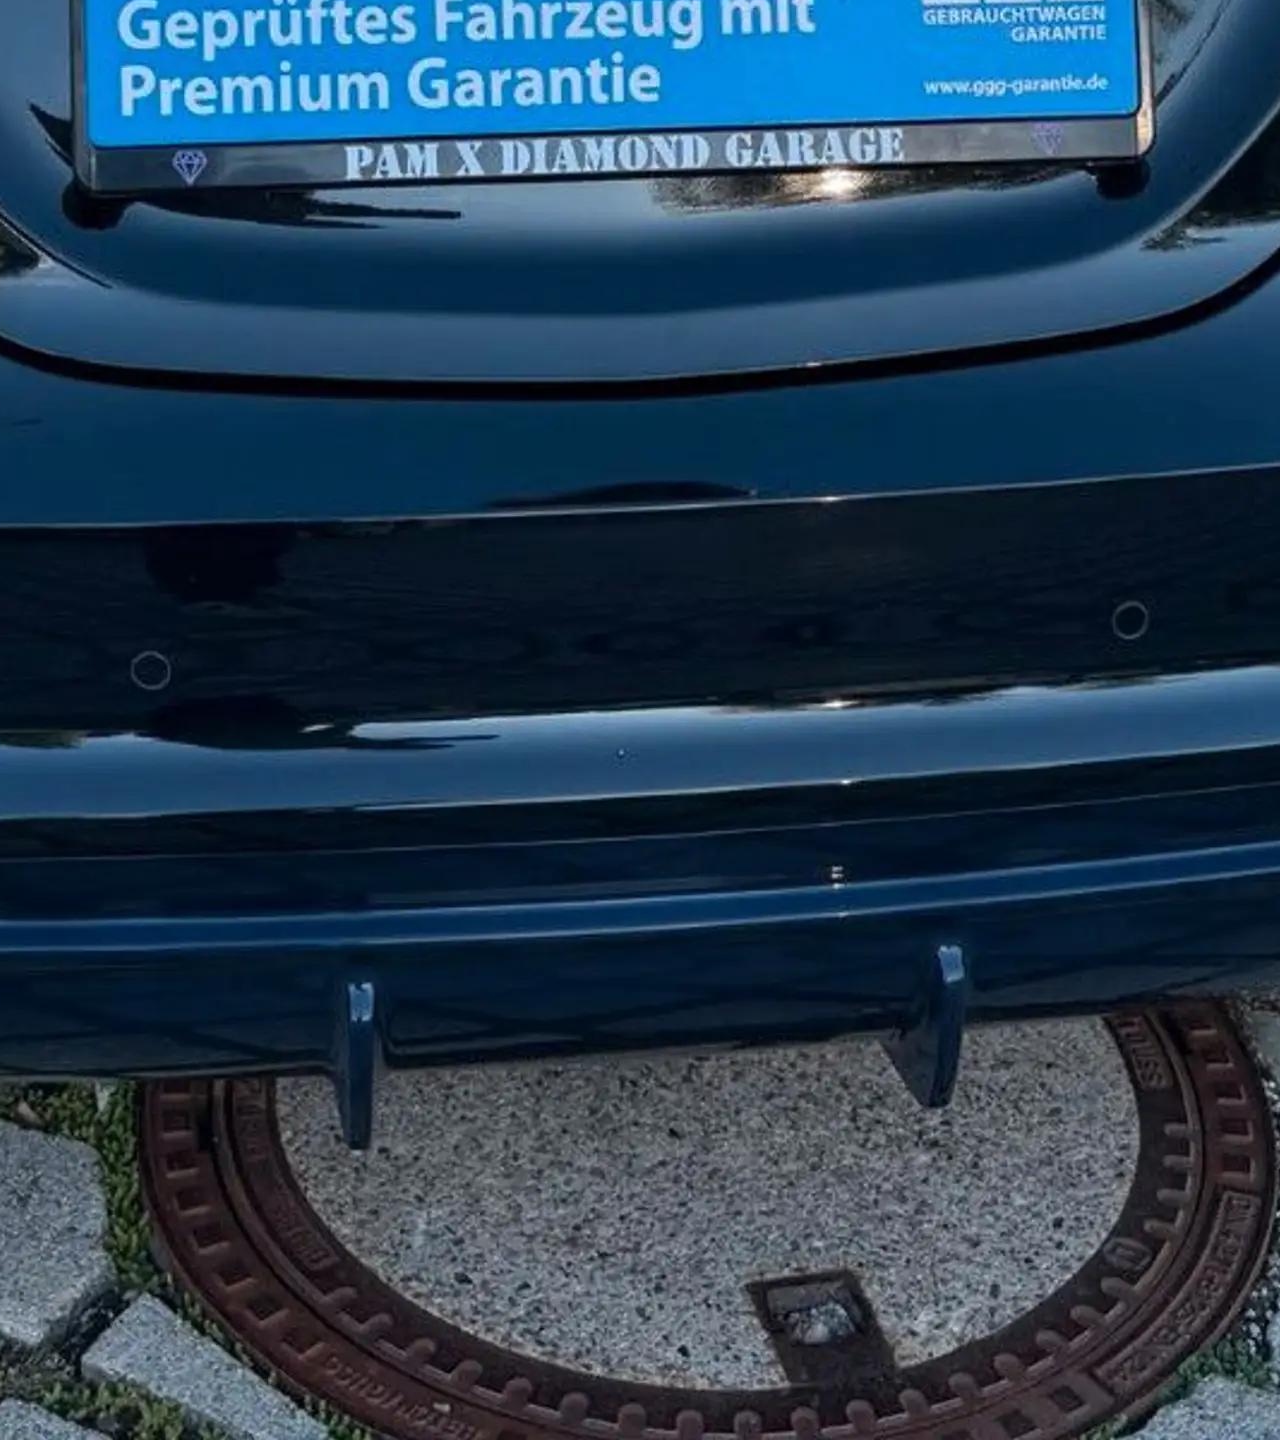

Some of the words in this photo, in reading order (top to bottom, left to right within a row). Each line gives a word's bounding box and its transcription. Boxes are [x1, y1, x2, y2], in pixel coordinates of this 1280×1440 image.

[923, 5, 1107, 26] GEBRAUCHTWAGEN
[1010, 24, 1107, 42] GARANTIE
[120, 60, 390, 117] Premium
[407, 51, 661, 109] Garantie
[923, 72, 1110, 98] www.ggg-garantie.de
[344, 141, 440, 181] PAM
[455, 141, 487, 178] X
[499, 133, 711, 176] DIAMOND
[724, 127, 904, 167] GARAGE
